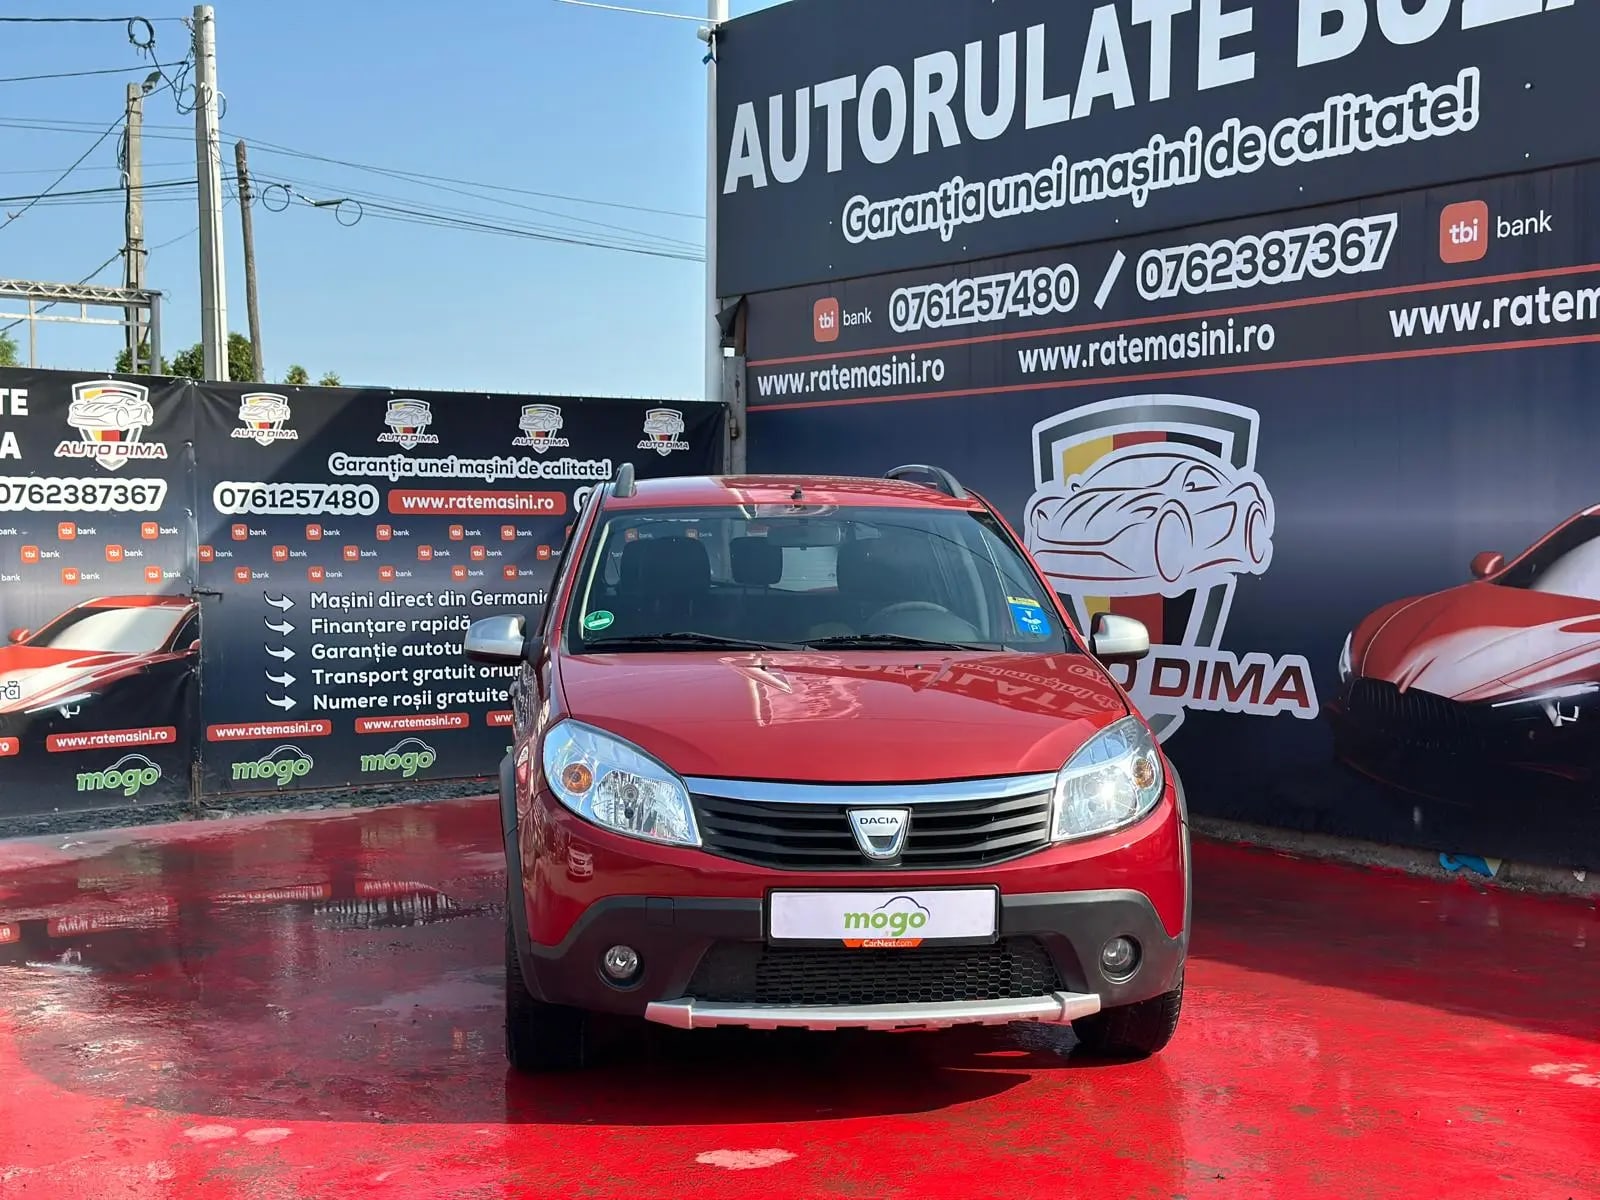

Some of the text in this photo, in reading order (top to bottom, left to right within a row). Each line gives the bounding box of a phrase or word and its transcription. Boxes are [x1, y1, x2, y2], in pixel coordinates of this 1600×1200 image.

[722, 0, 1256, 194] AUTORULATE
[845, 74, 1474, 236] Garanția unei mașini de calitate!
[1449, 209, 1553, 244] tbi bank
[891, 266, 1076, 330] 0761257480
[1139, 218, 1394, 296] 0762387367
[818, 307, 873, 330] tbi bank
[1388, 286, 1600, 338] www.ratem
[1017, 320, 1276, 374] www.ratemasini.ro
[757, 353, 945, 396] www.ratemasini.ro
[232, 428, 297, 439] AUTO DIMA
[378, 433, 438, 444] AUTO DIMA
[514, 437, 569, 447] AUTO DIMA
[638, 440, 689, 450] AUTO DIMA
[57, 442, 165, 457] AUTO DIMA
[332, 455, 610, 480] Garanția unei mașini de calitate!
[0, 483, 162, 506] 0762387367
[218, 486, 375, 511] 0761257480
[401, 494, 555, 511] www.ratemasini.ro
[309, 591, 374, 614] Mașini
[378, 590, 434, 608] direct
[438, 590, 467, 608] din
[311, 615, 471, 639] Finanțare rapidă
[311, 642, 398, 664] Garanție
[311, 668, 409, 689] Transport
[412, 663, 476, 684] gratuit
[1149, 657, 1311, 709] DIMA
[312, 689, 509, 713] Numere roșii gratuite
[215, 721, 324, 738] www.ratemasini.ro
[362, 714, 462, 731] www.ratemasini.ro
[55, 729, 168, 748] www.ratemasini.ro
[231, 756, 311, 786] mogo
[360, 749, 434, 778] mogo
[76, 766, 159, 797] mogo
[859, 816, 899, 826] DACIA
[843, 911, 927, 937] mogo
